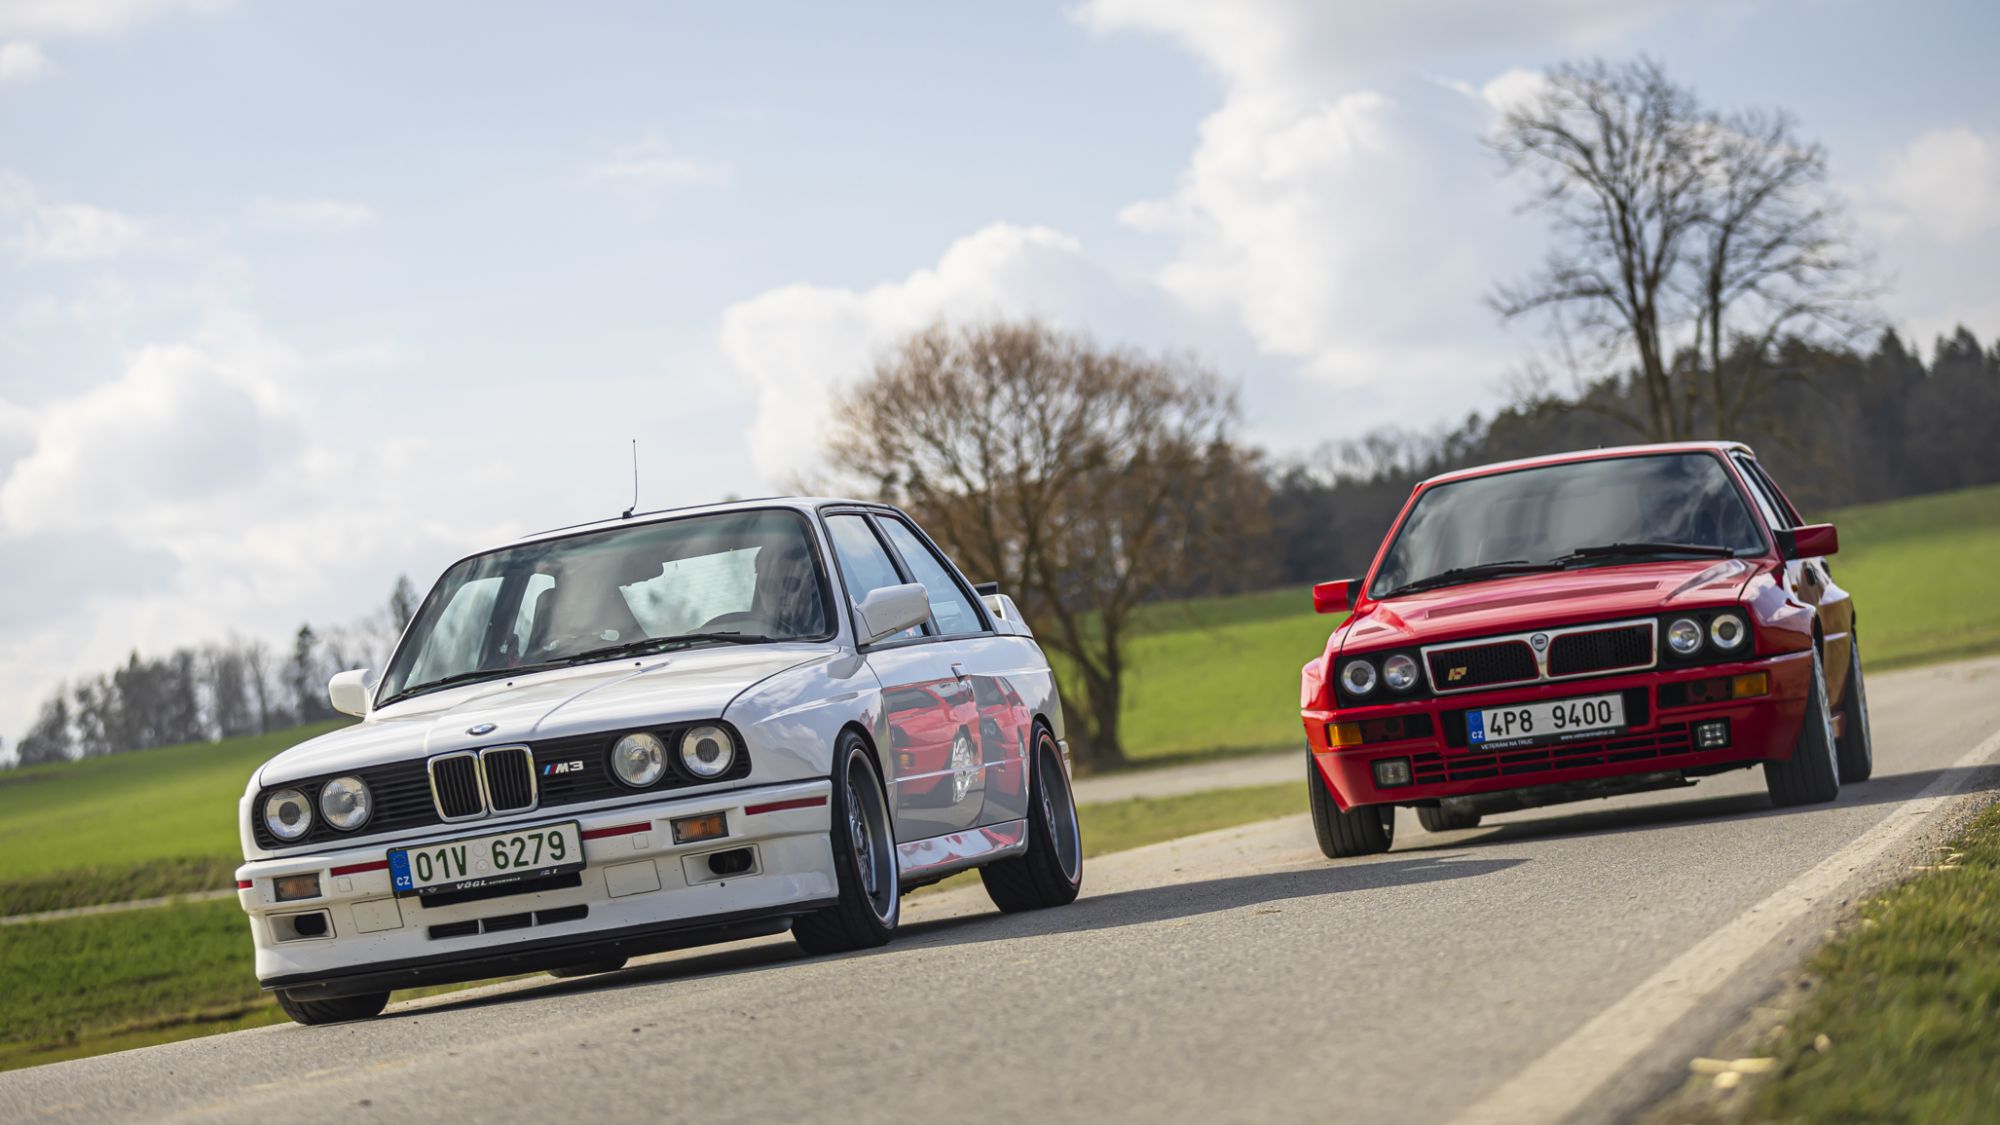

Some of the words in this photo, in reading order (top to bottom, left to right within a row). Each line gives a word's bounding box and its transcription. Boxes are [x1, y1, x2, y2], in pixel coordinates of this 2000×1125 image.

[1490, 709, 1533, 736] 4P8
[1552, 699, 1612, 729] 9400
[1471, 730, 1483, 740] CZ
[555, 760, 584, 774] M3
[415, 845, 467, 882] 01V
[491, 830, 566, 870] 6279
[396, 875, 411, 887] CZ
[456, 879, 487, 890] VÖGL
